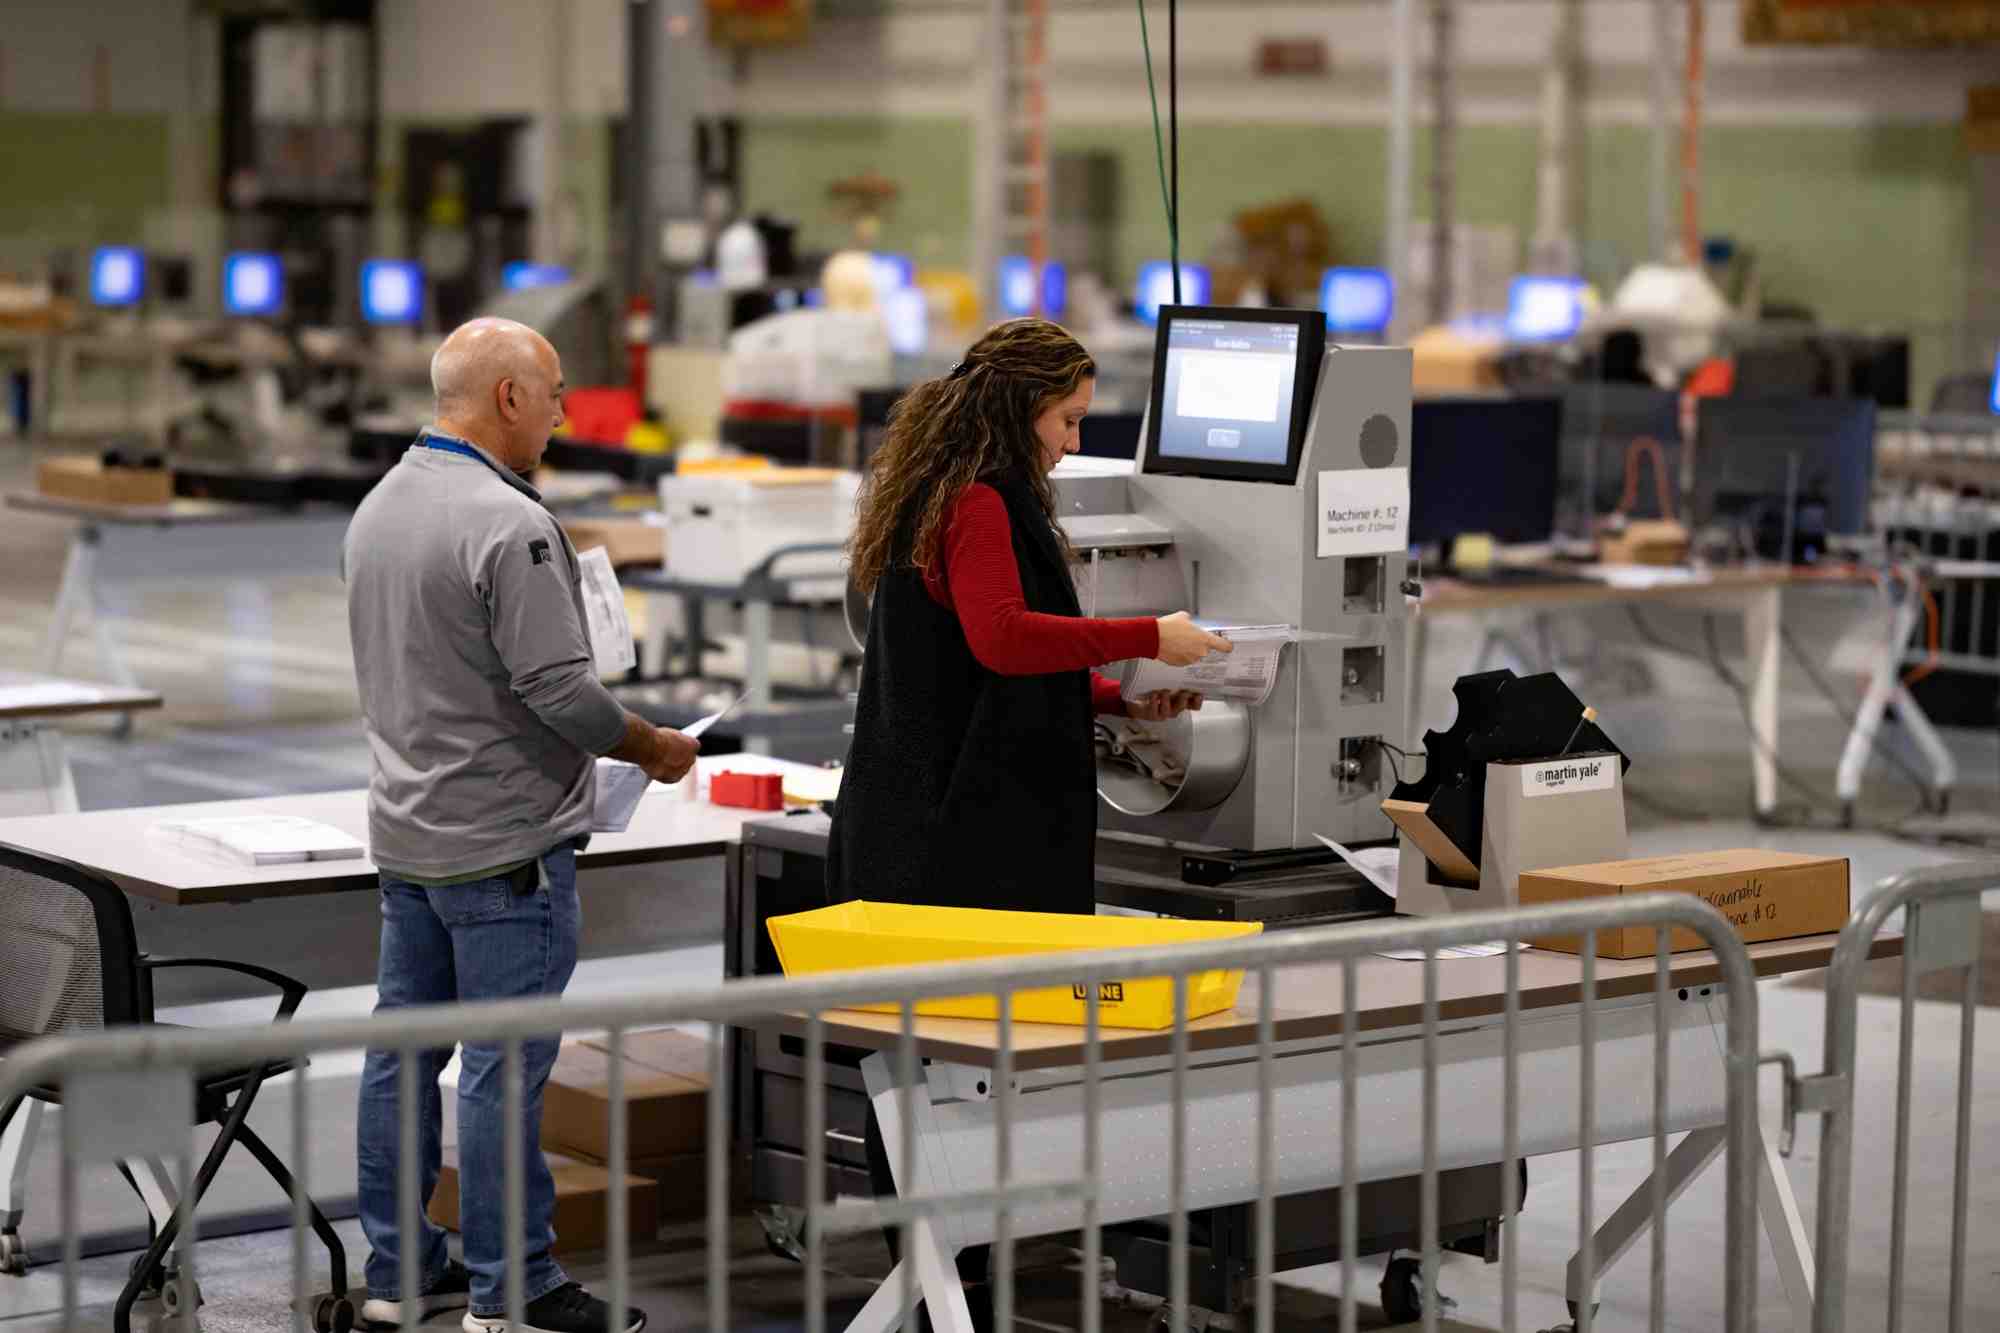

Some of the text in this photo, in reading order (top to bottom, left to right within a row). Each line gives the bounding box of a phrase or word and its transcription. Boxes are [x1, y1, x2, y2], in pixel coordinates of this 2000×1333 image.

[1327, 509, 1370, 521] Machine
[1386, 505, 1399, 519] 12
[1545, 764, 1577, 782] martin
[1074, 983, 1122, 1000] UNE
